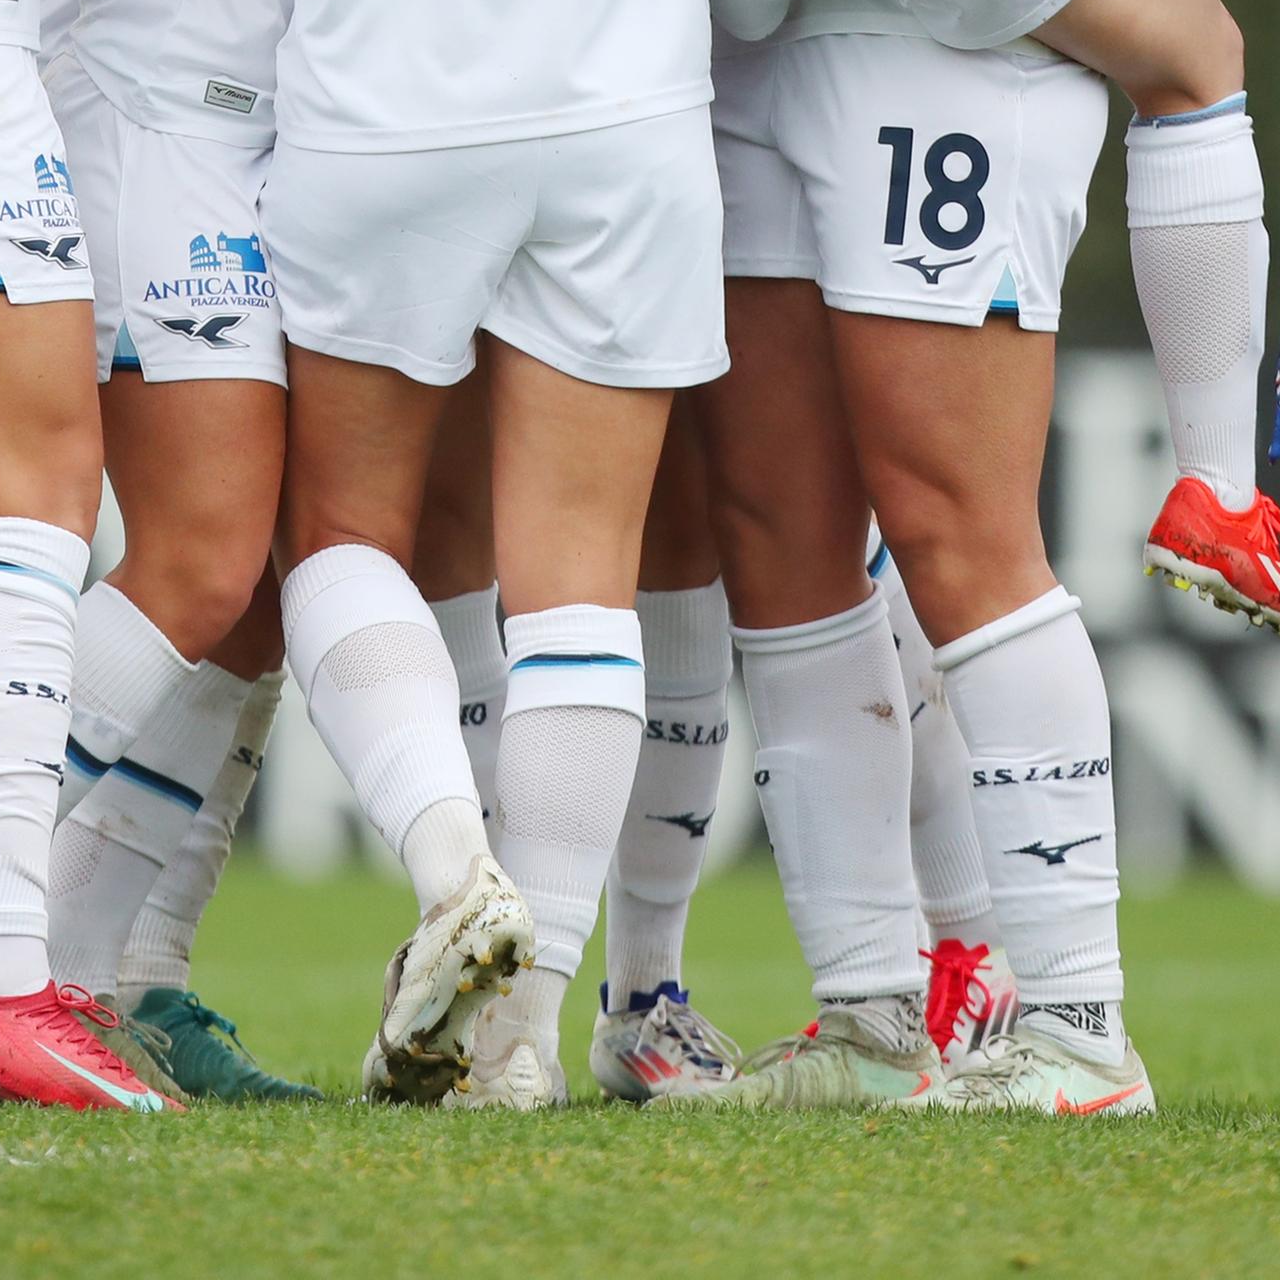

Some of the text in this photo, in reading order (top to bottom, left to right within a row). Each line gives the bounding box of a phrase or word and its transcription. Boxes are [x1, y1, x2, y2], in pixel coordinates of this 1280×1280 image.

[877, 126, 990, 251] 18
[0, 199, 73, 222] ANTICA
[144, 274, 275, 302] ANTICA RO
[191, 297, 270, 308] PIAZZA VENEZIA
[1023, 757, 1110, 781] LAZIO
